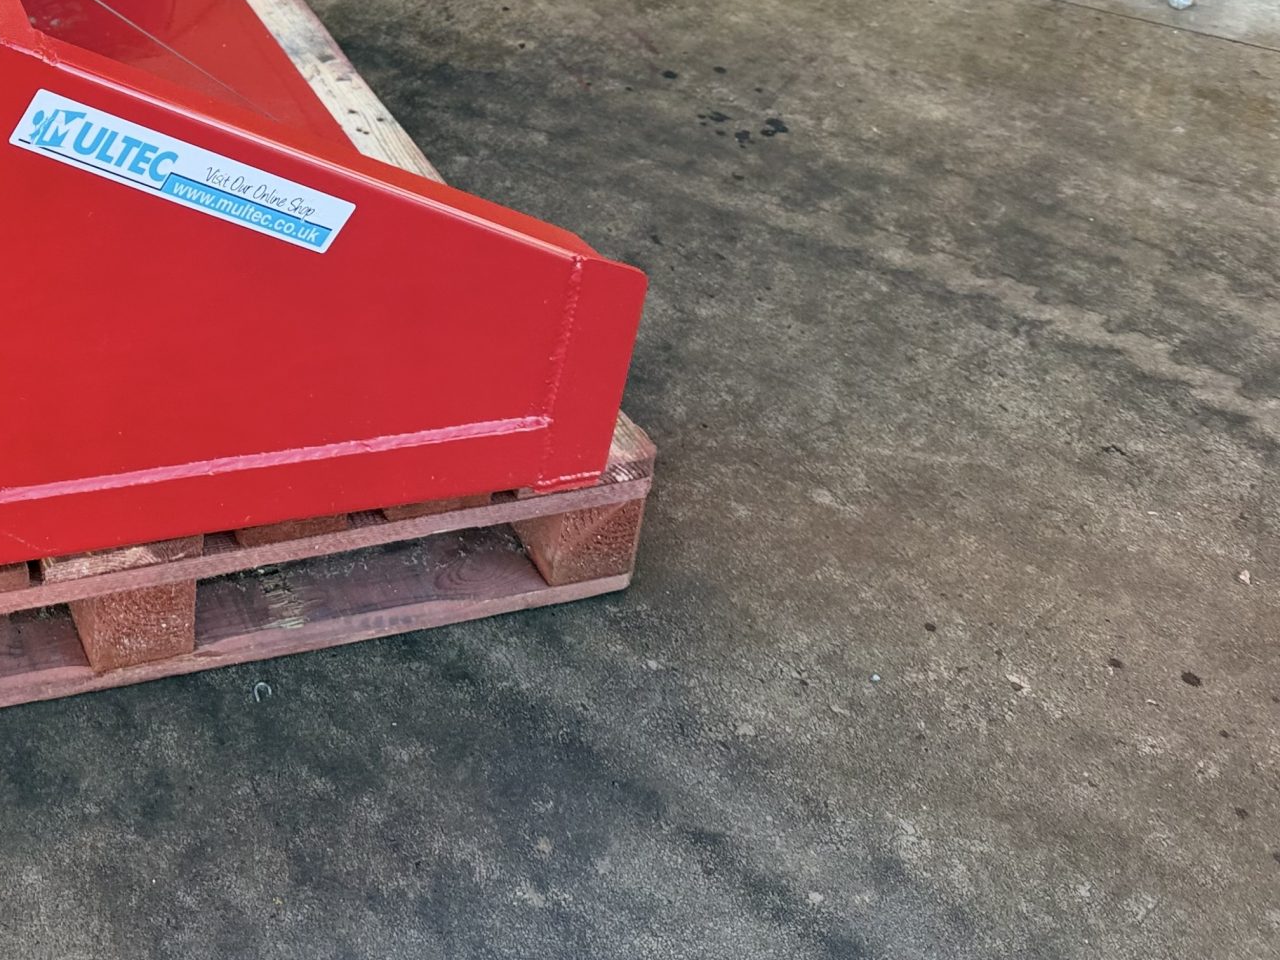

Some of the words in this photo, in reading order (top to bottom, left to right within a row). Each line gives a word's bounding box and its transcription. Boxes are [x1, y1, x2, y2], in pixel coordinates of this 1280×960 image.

[33, 108, 180, 183] MULTEC
[172, 181, 321, 243] www.multec.co.uk
[206, 166, 231, 187] Visit
[229, 175, 253, 194] Our
[252, 184, 287, 208] Online
[287, 197, 316, 221] Shop
